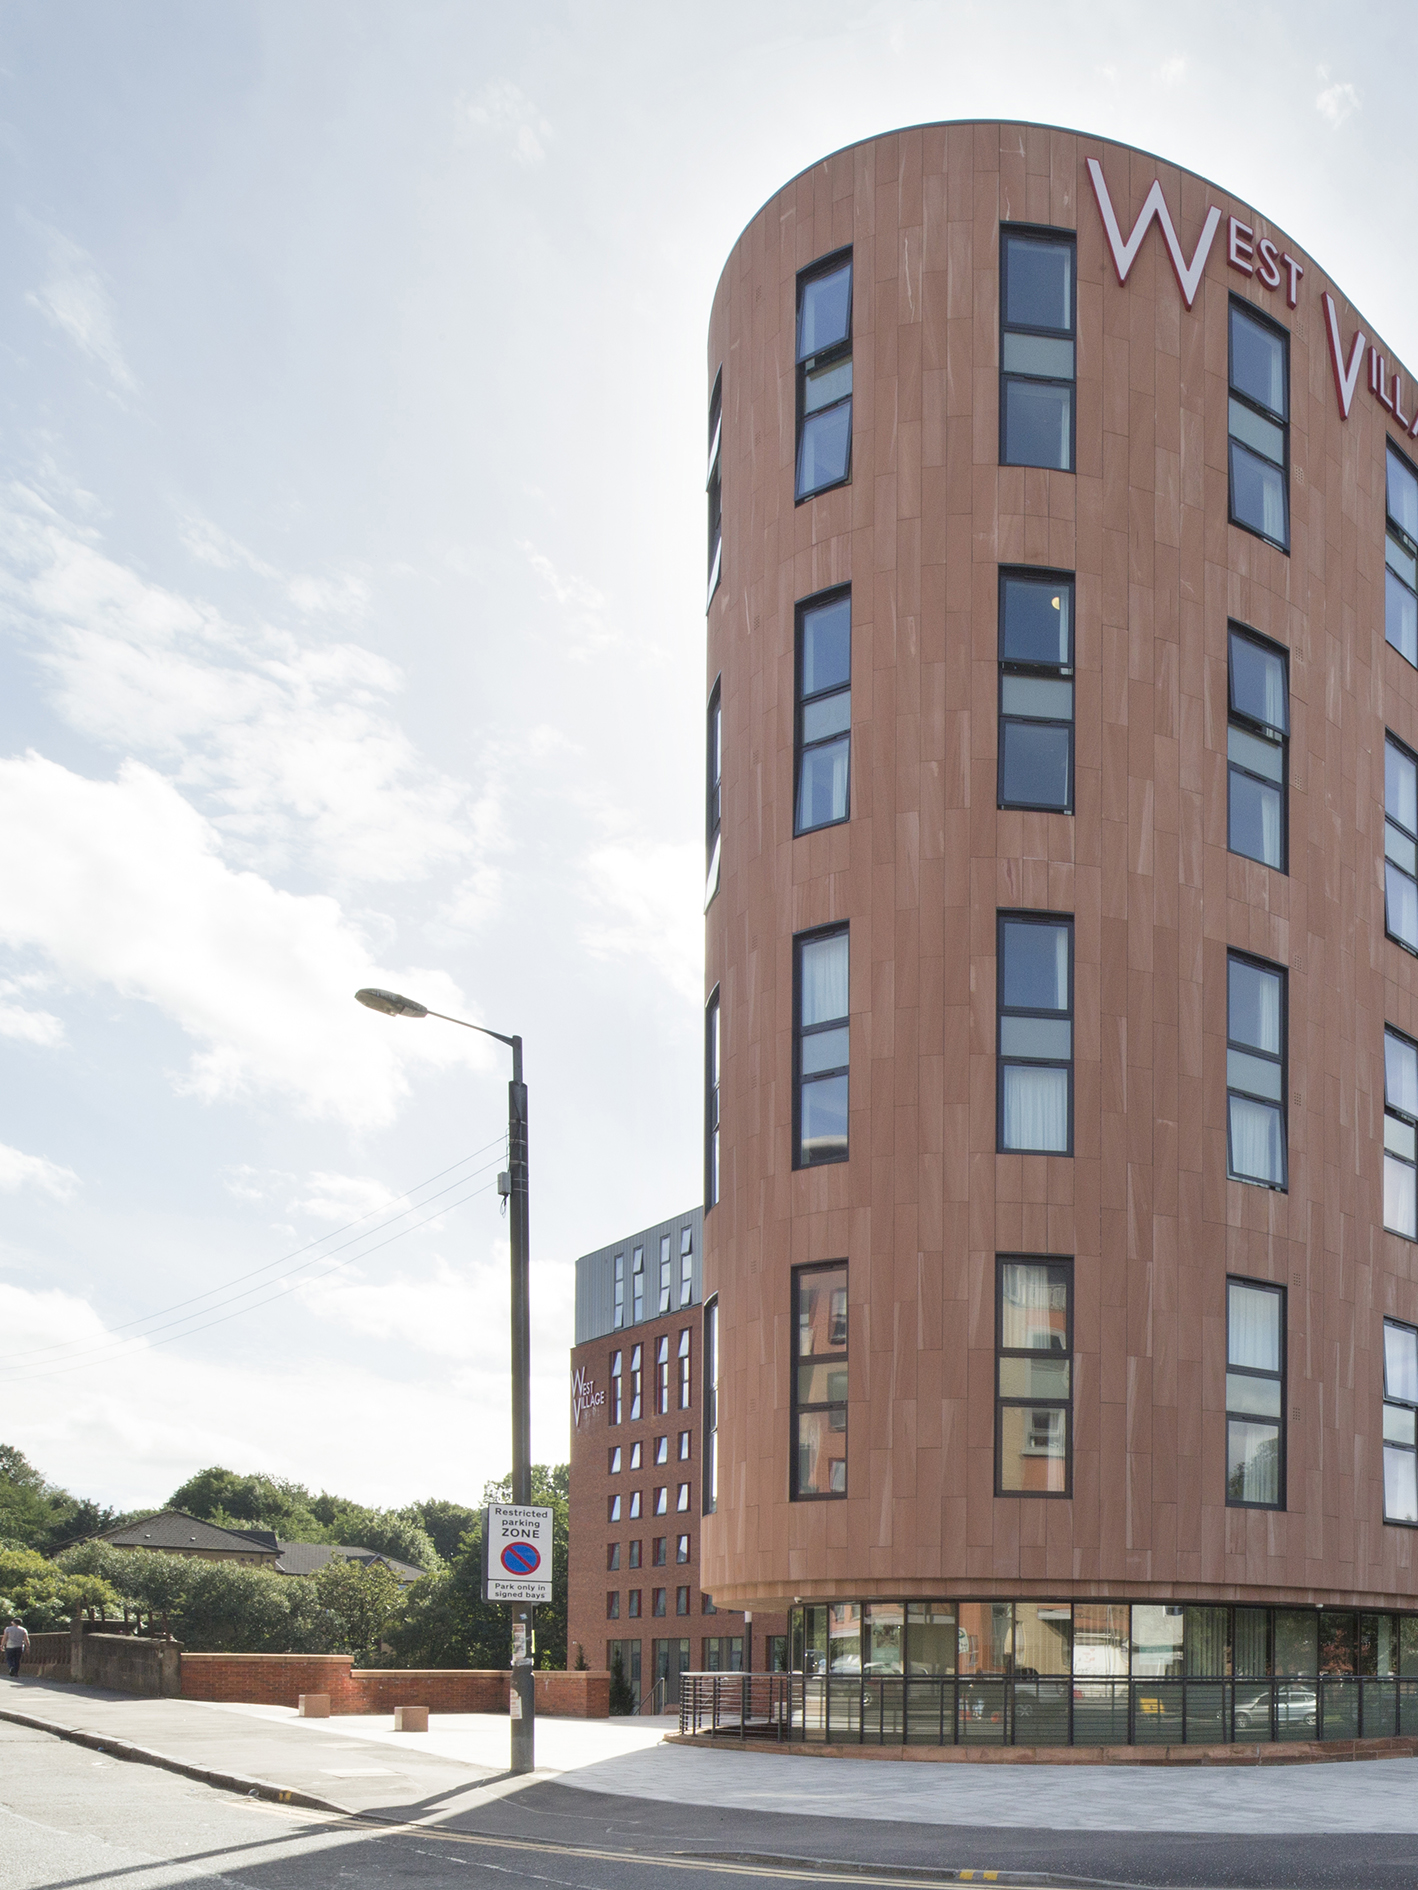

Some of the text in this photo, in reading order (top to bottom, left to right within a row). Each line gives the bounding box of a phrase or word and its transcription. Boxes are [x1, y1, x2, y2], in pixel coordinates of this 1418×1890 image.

[1085, 156, 1303, 312] WEST
[570, 1366, 594, 1399] WEST
[495, 1507, 548, 1518] Restricted
[502, 1519, 540, 1529] parking
[502, 1528, 540, 1538] ZONE
